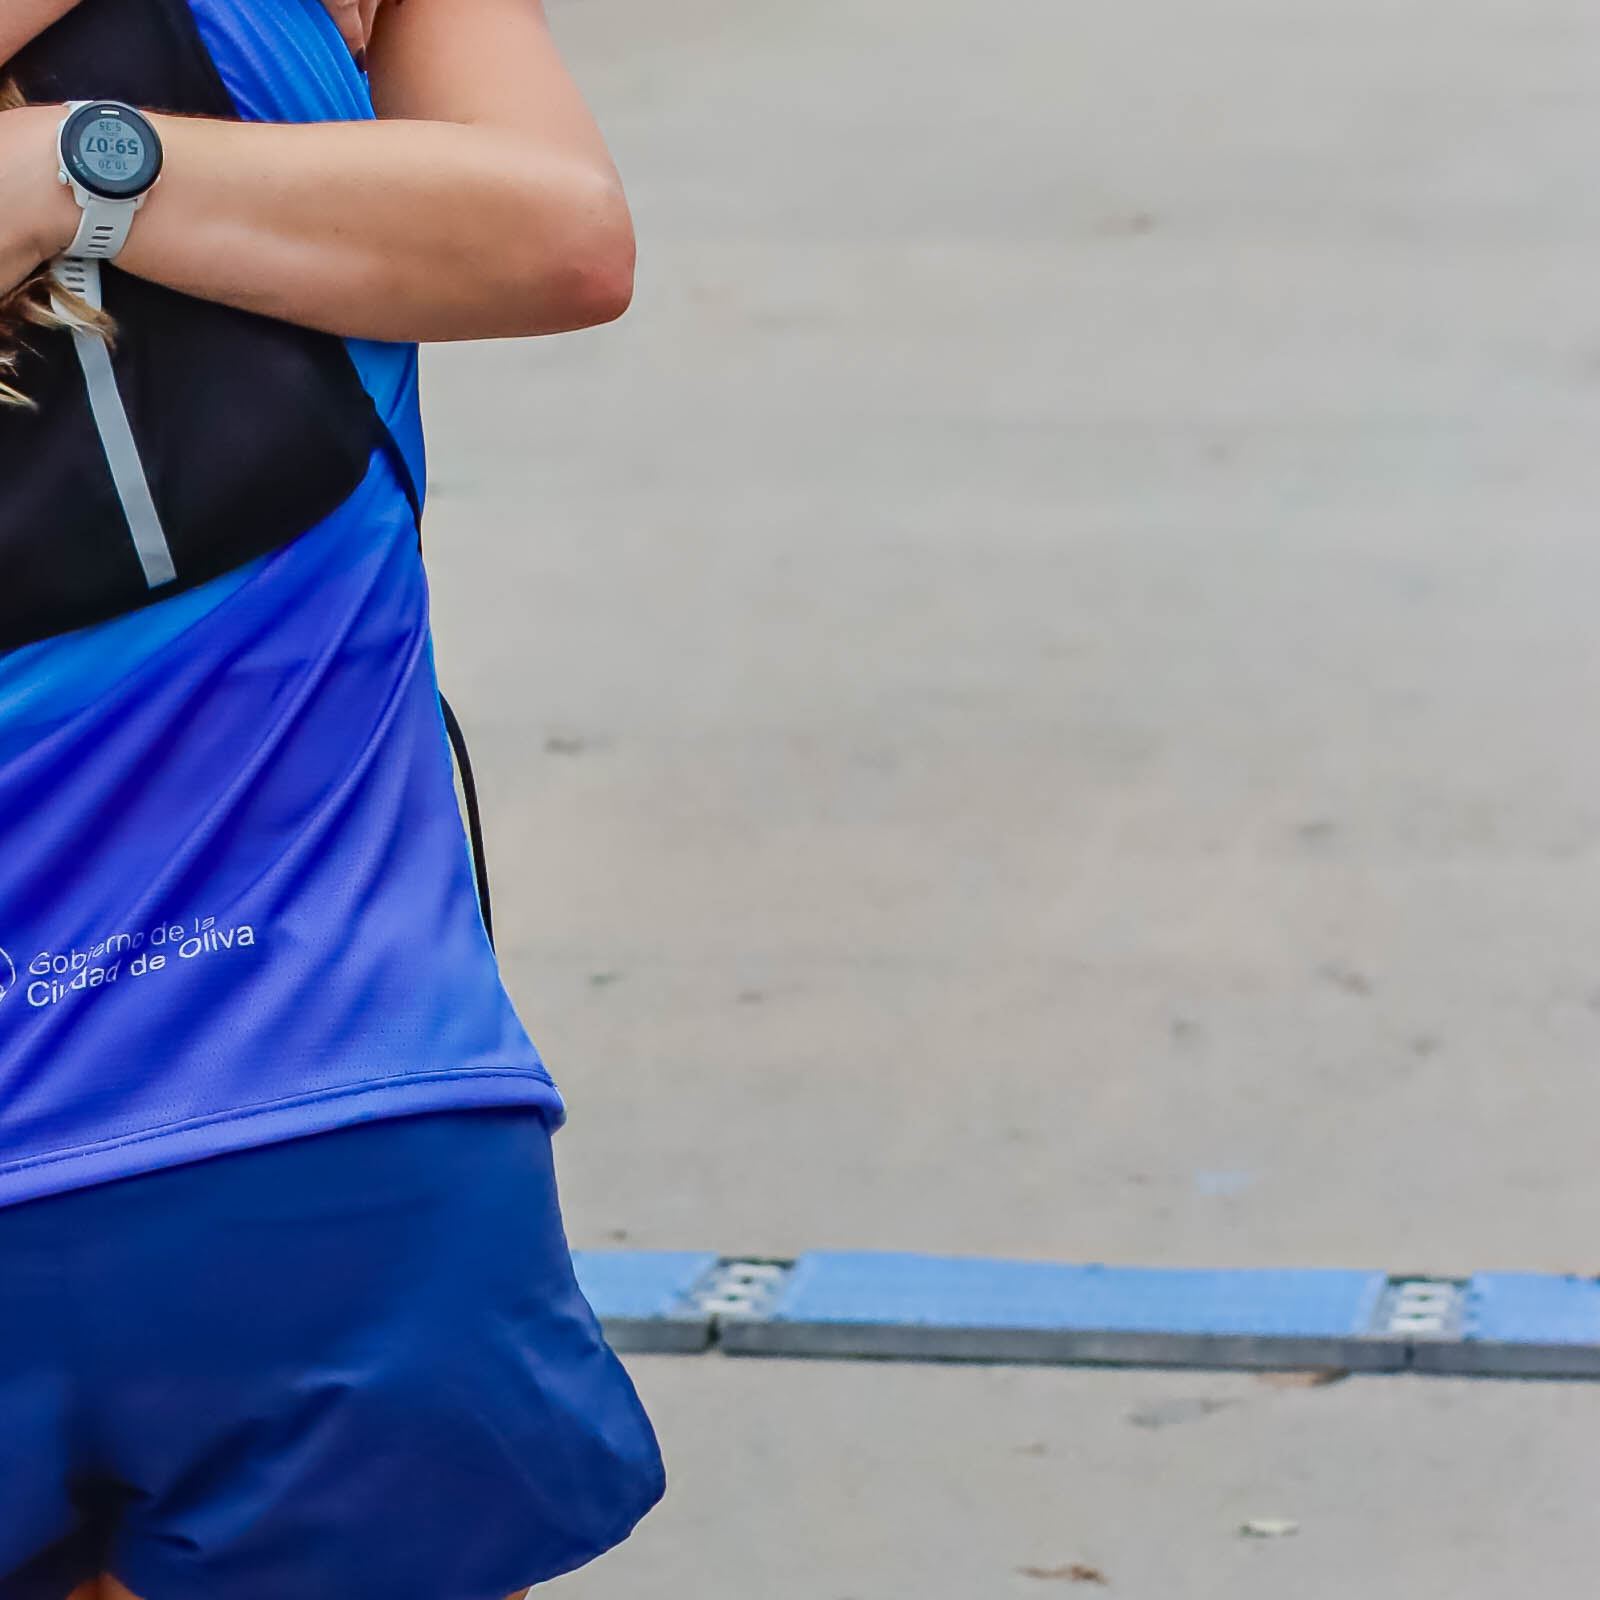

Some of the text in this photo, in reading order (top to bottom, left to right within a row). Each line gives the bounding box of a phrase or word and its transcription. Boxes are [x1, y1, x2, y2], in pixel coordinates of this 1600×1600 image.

[85, 136, 138, 155] 59:07
[27, 925, 255, 1007] Ciudad de Oliva
[29, 916, 215, 975] Gobierno de la
